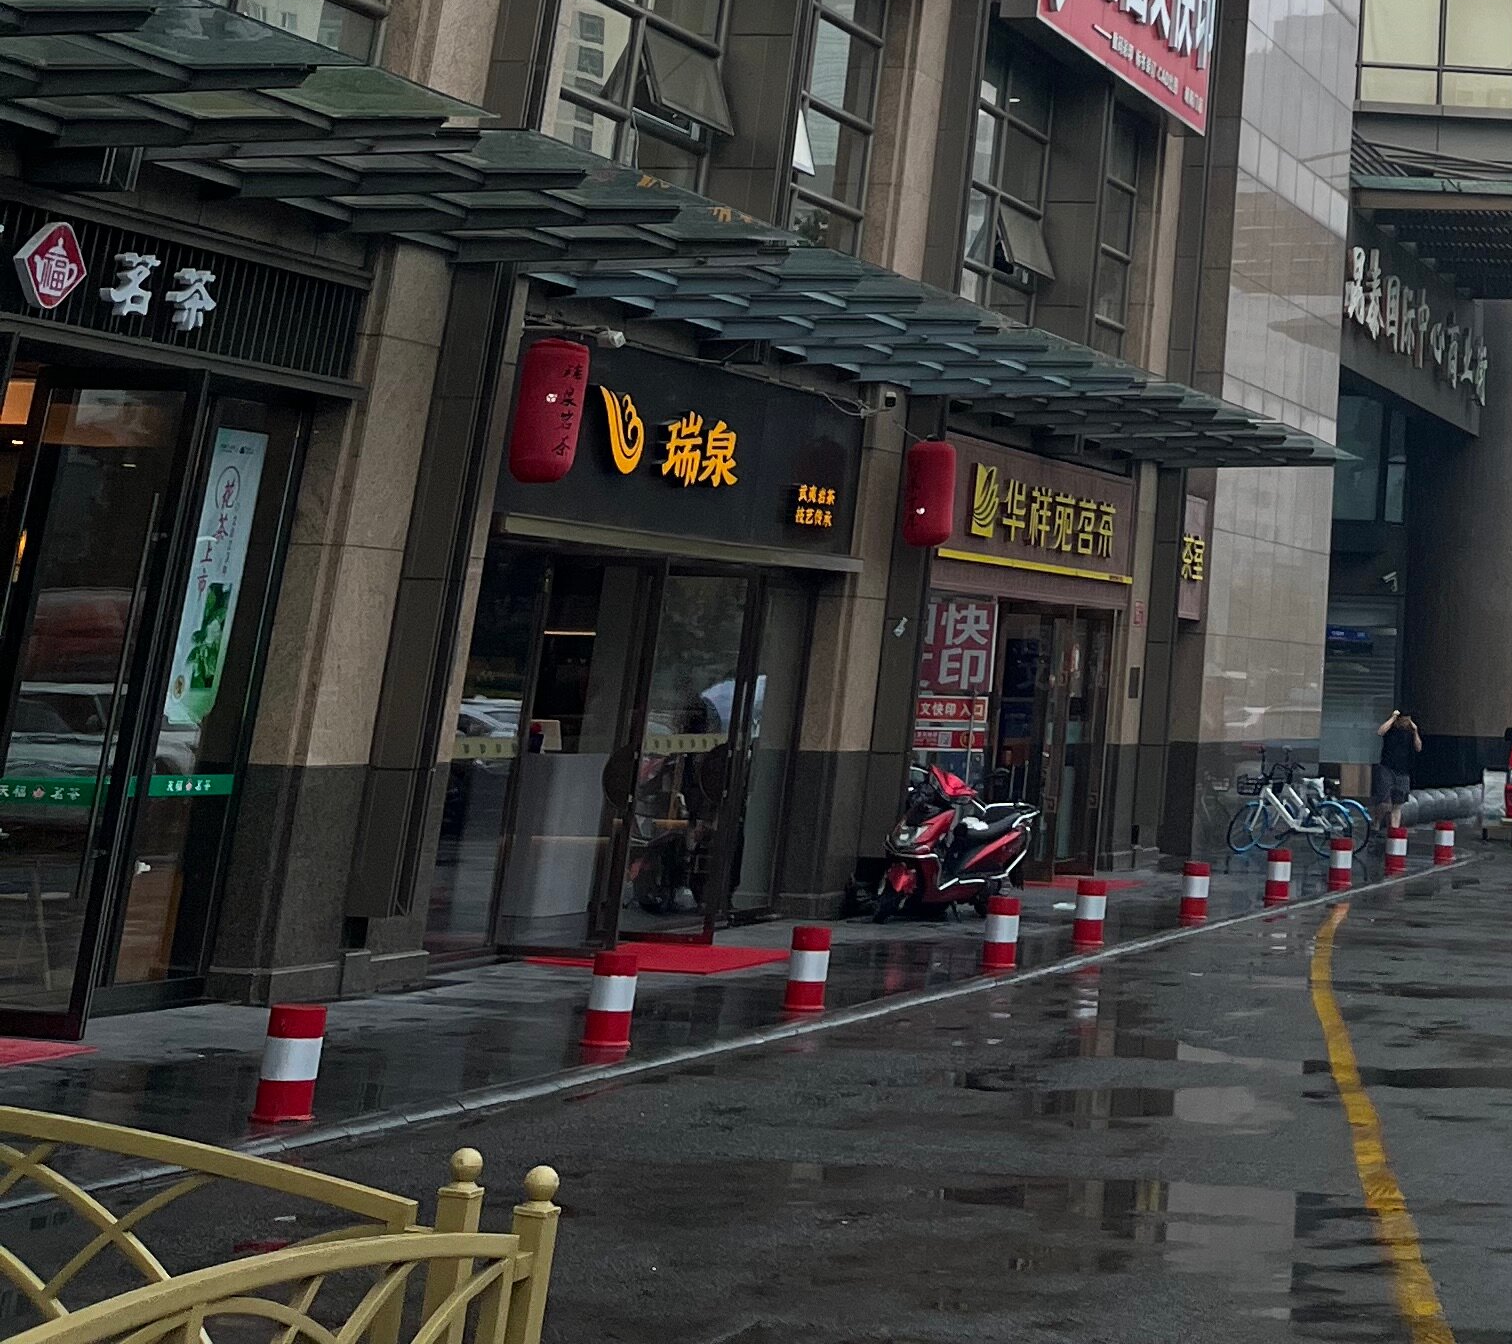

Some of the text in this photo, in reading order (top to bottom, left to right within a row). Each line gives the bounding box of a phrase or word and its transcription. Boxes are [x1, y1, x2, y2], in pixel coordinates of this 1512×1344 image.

[106, 252, 217, 331] 茗茶
[661, 410, 739, 487] 瑞泉
[1000, 478, 1117, 558] 华祥苑茗茶
[938, 603, 991, 690] 快印
